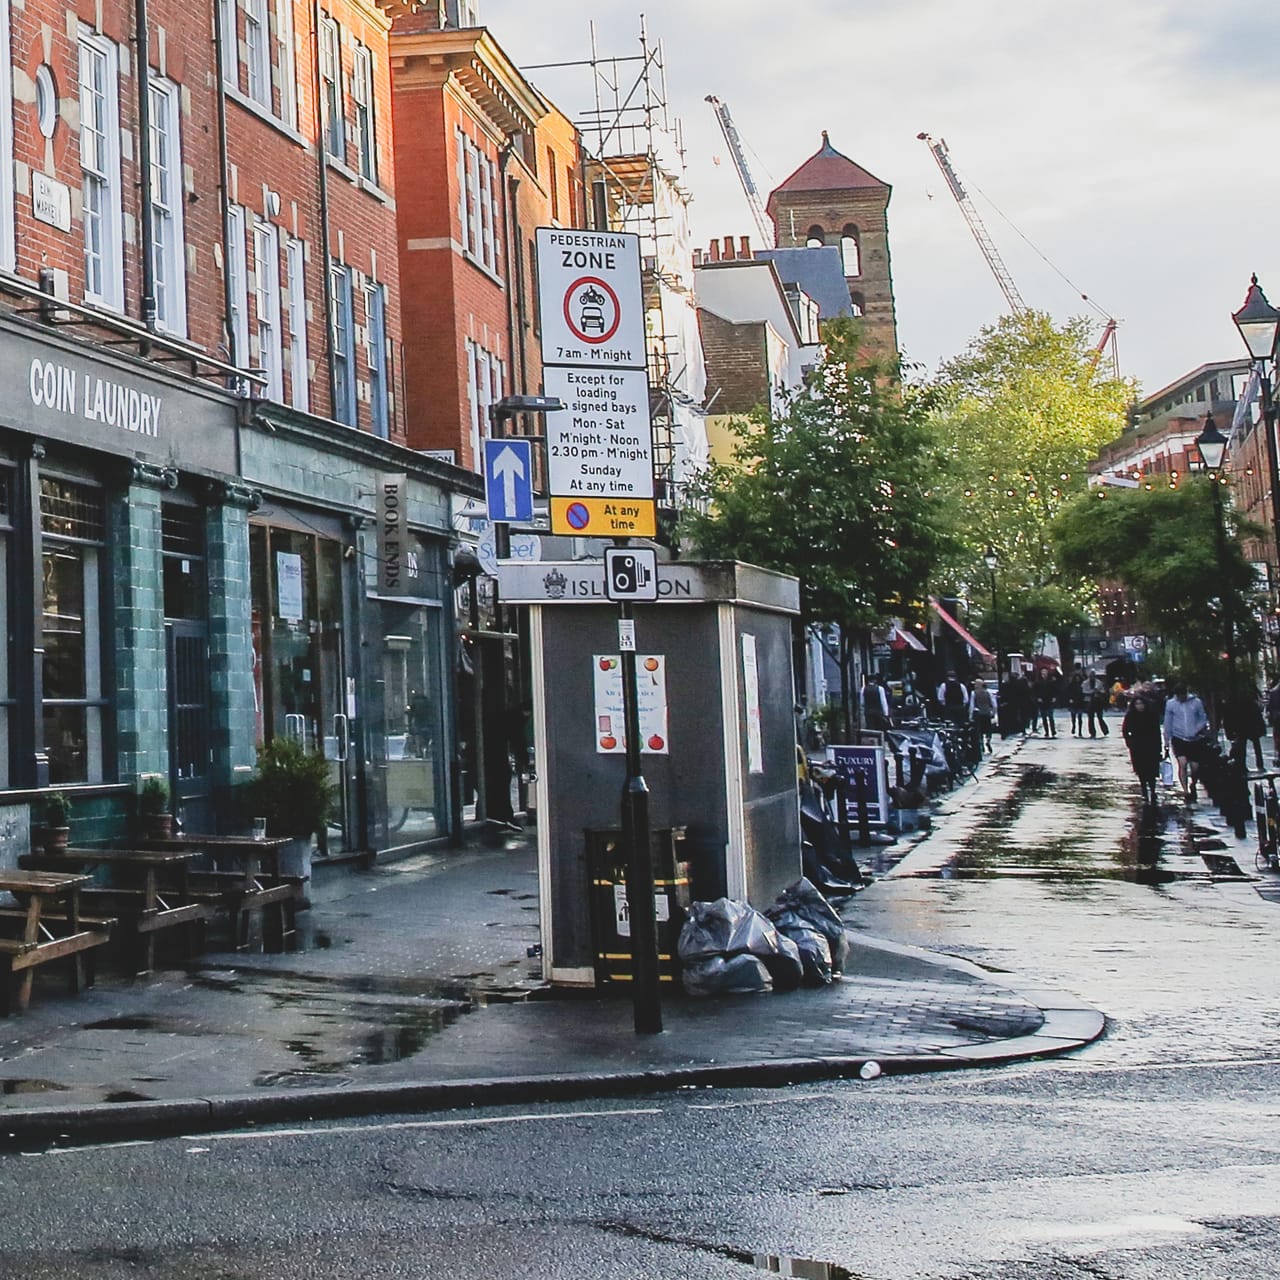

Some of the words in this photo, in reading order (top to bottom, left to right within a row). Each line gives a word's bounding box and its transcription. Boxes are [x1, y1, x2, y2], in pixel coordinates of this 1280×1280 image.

[550, 234, 626, 249] PEDESTRIAN
[561, 250, 616, 270] ZONE
[567, 372, 605, 386] Except
[609, 374, 625, 386] for
[30, 358, 76, 415] COIN
[83, 375, 163, 437] LAUNDRY
[576, 387, 617, 400] loading
[572, 401, 608, 413] signed
[611, 402, 637, 414] bays
[573, 417, 597, 429] Mon
[605, 418, 625, 430] Sat
[610, 434, 640, 446] Noon
[580, 463, 622, 477] Sunday
[570, 479, 583, 490] At
[586, 481, 606, 493] any
[609, 480, 634, 492] time
[384, 484, 399, 537] BOOK
[604, 504, 618, 515] At
[620, 506, 640, 518] any
[610, 519, 636, 530] time
[384, 540, 399, 589] ENDS
[571, 578, 691, 597] ISLION
